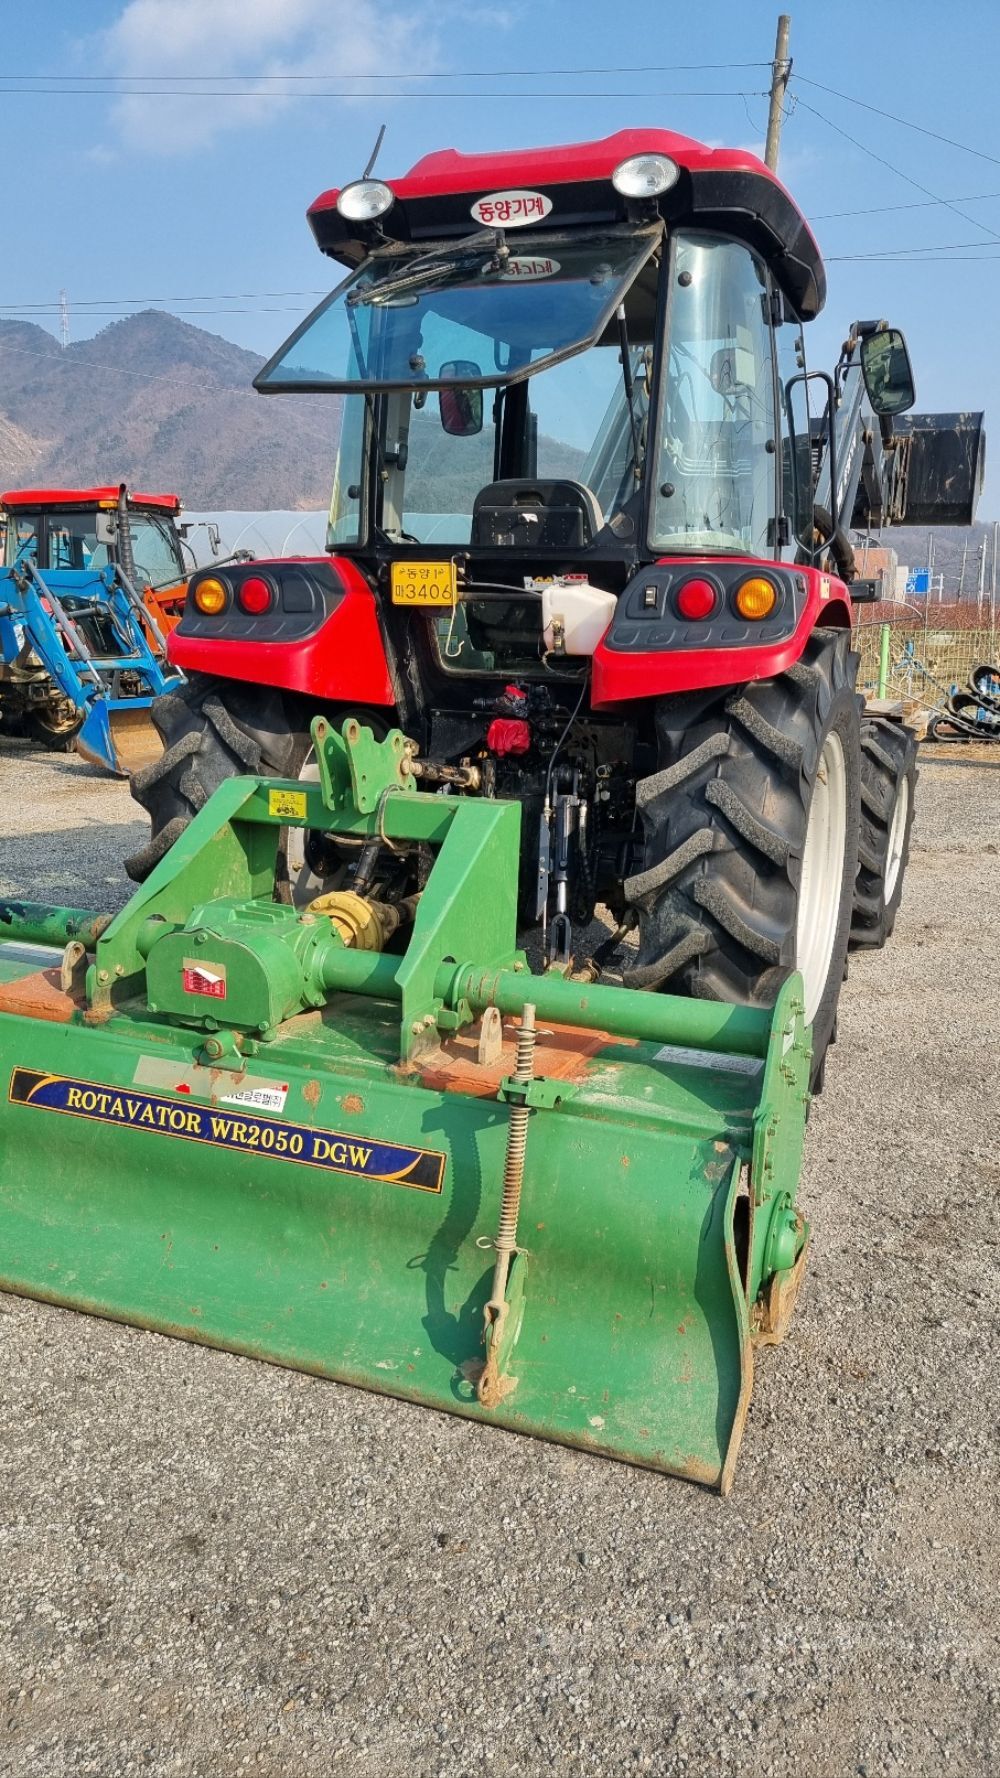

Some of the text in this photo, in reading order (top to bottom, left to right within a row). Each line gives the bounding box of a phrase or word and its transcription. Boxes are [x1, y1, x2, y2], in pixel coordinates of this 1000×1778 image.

[478, 196, 545, 223] 동양기계
[66, 1087, 373, 1169] ROTAVATOR WR2050 DGW
